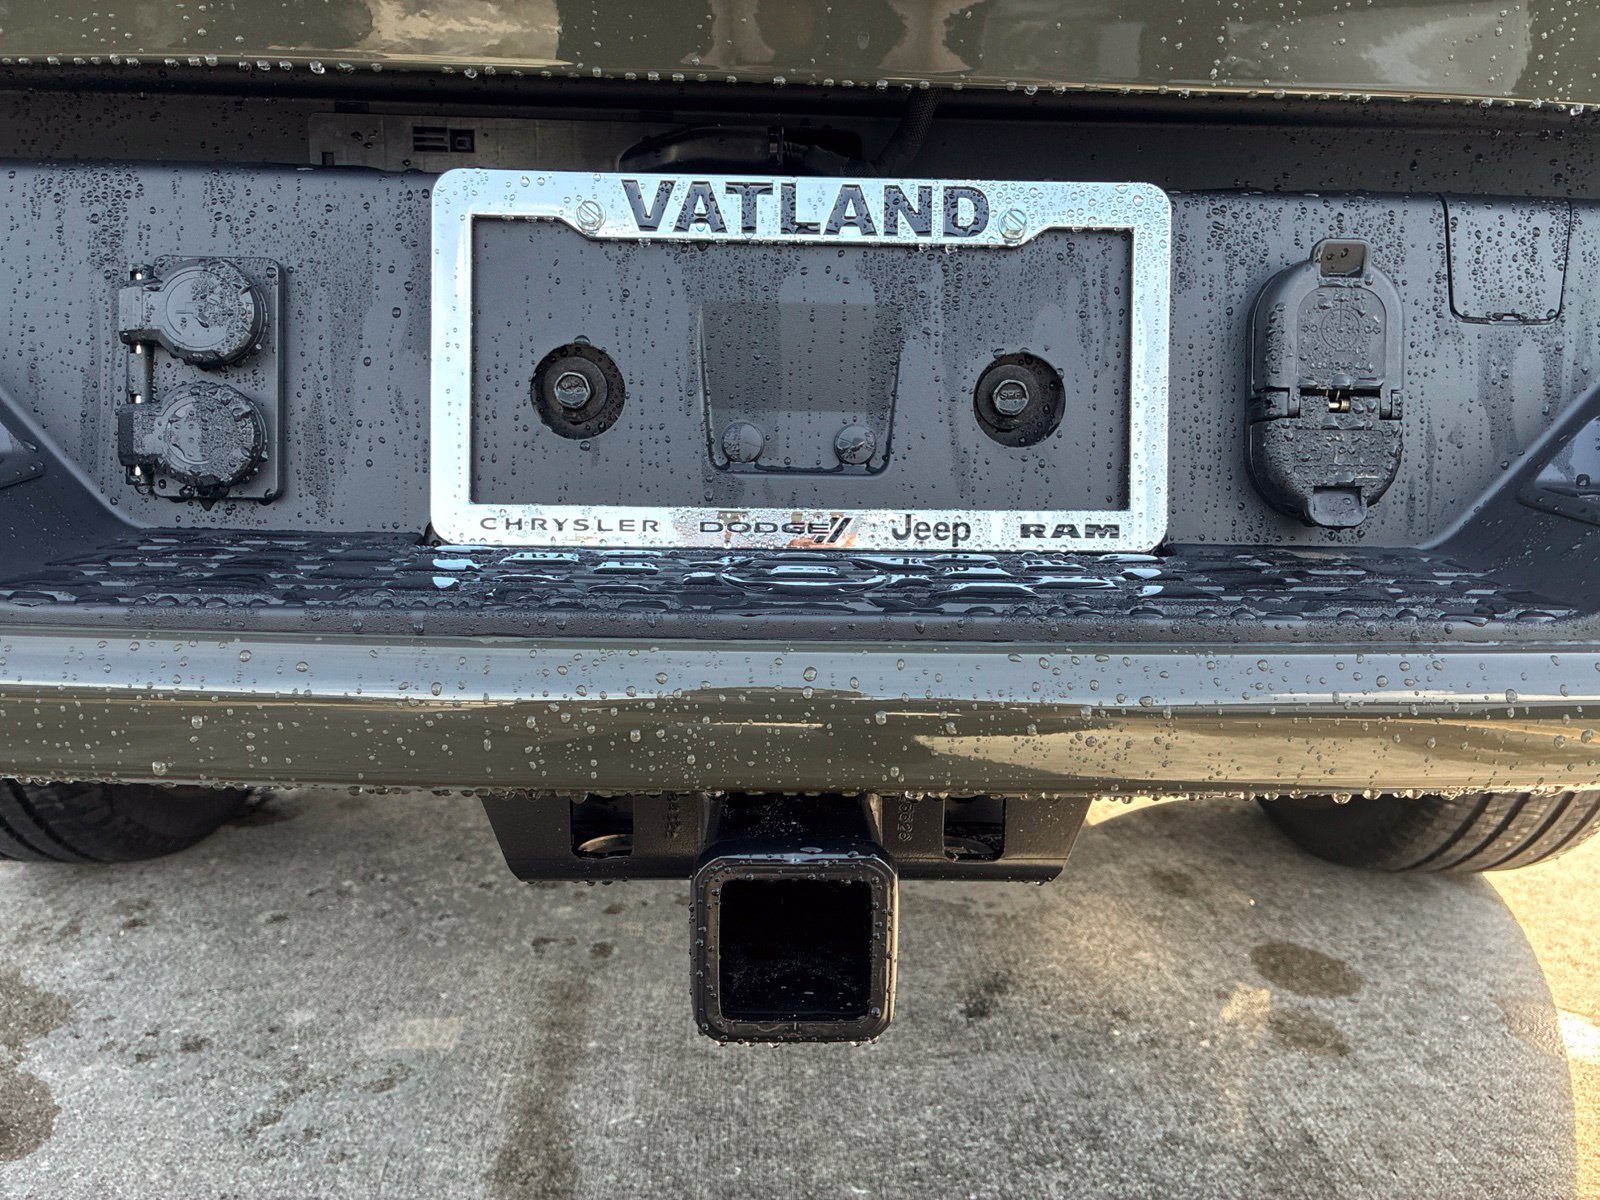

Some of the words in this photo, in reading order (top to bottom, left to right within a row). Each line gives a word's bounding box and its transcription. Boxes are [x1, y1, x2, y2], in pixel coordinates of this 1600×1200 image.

[620, 179, 990, 238] VATLAND
[480, 517, 660, 533] CHRYSLER
[699, 520, 832, 536] DODGE
[891, 514, 972, 547] Jeep
[1020, 523, 1120, 539] RAM
